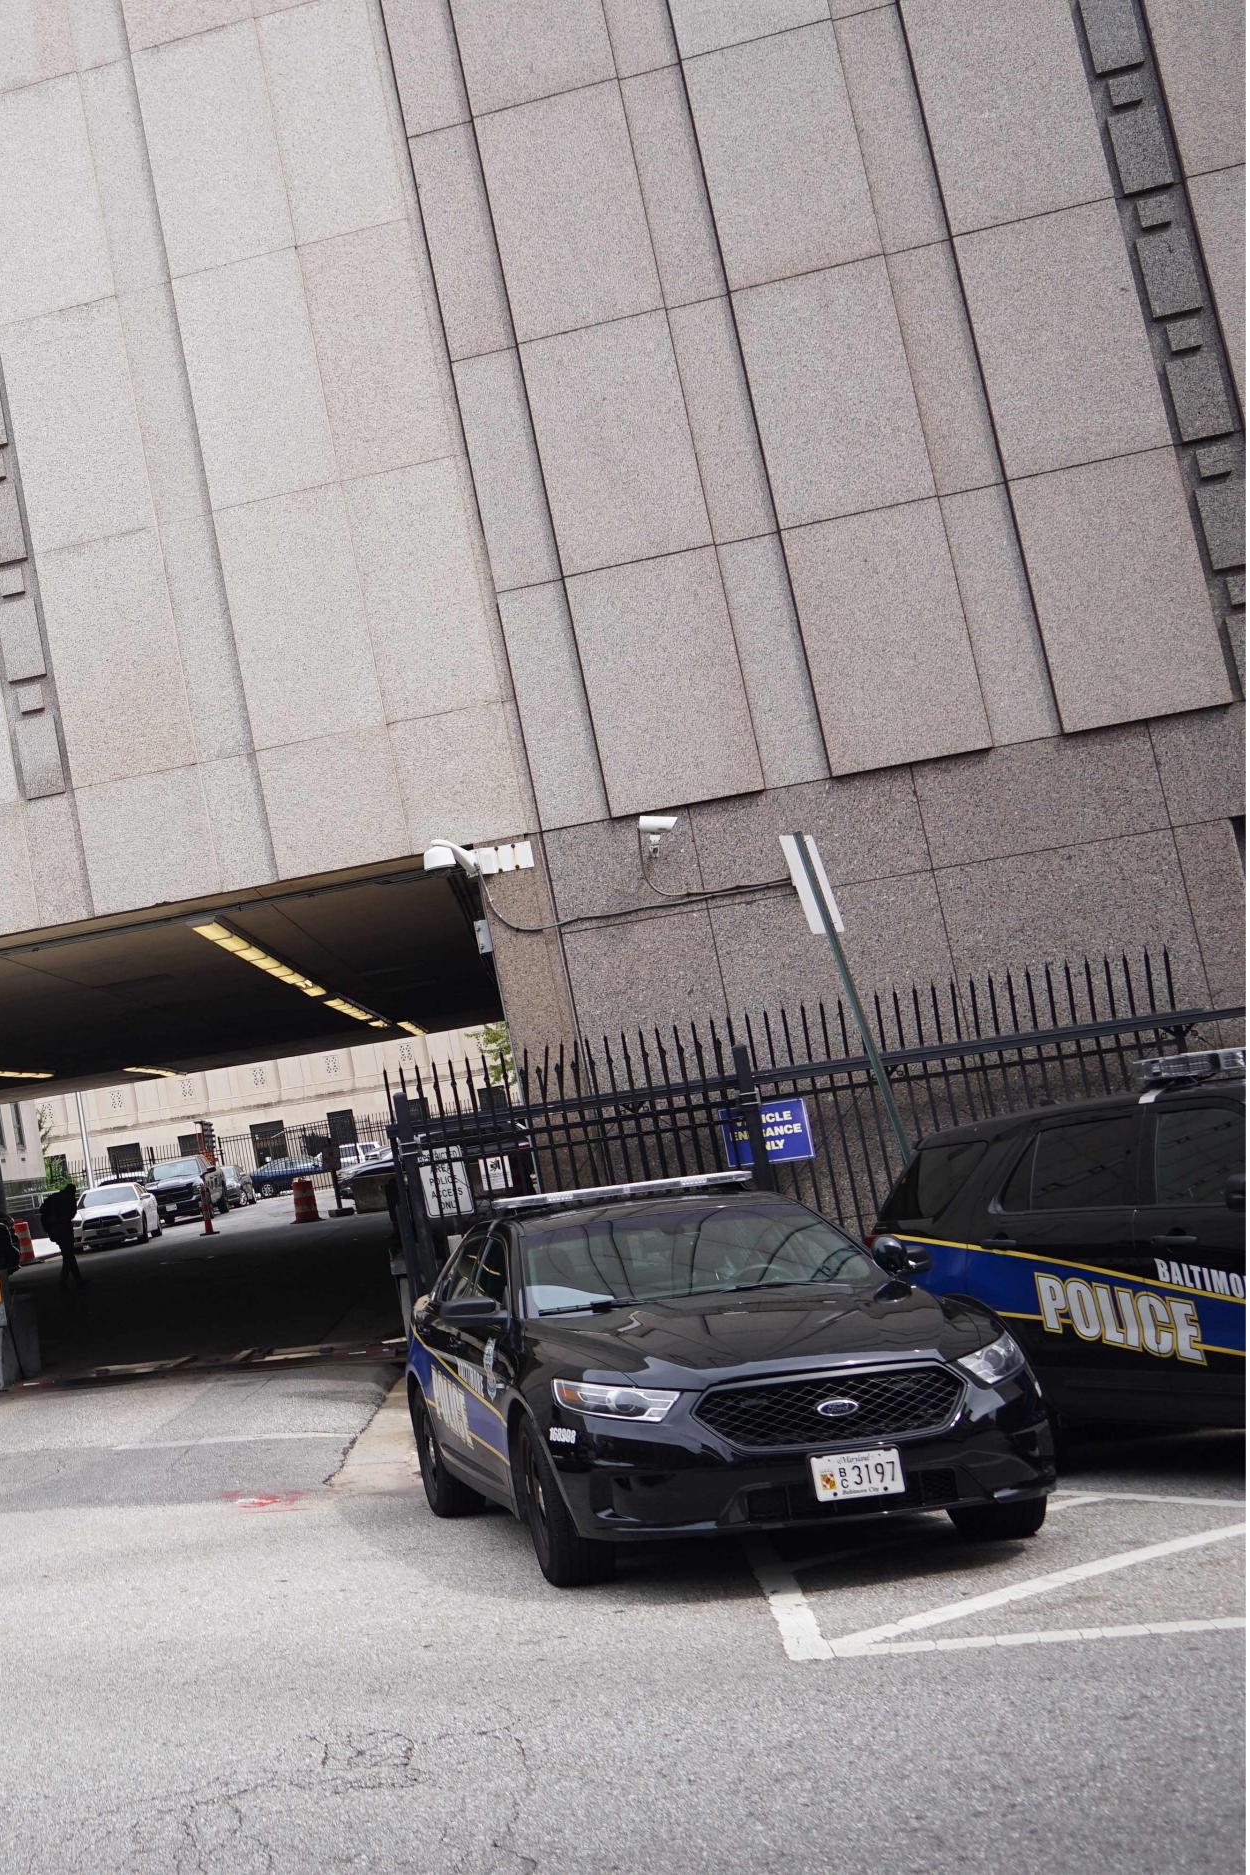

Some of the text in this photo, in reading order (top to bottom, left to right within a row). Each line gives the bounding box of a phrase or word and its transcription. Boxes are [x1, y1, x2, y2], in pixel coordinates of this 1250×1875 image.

[1153, 1257, 1246, 1299] BALTIMO
[1034, 1271, 1208, 1366] POLICE
[838, 1453, 871, 1464] Maryland
[851, 1460, 896, 1486] 3197
